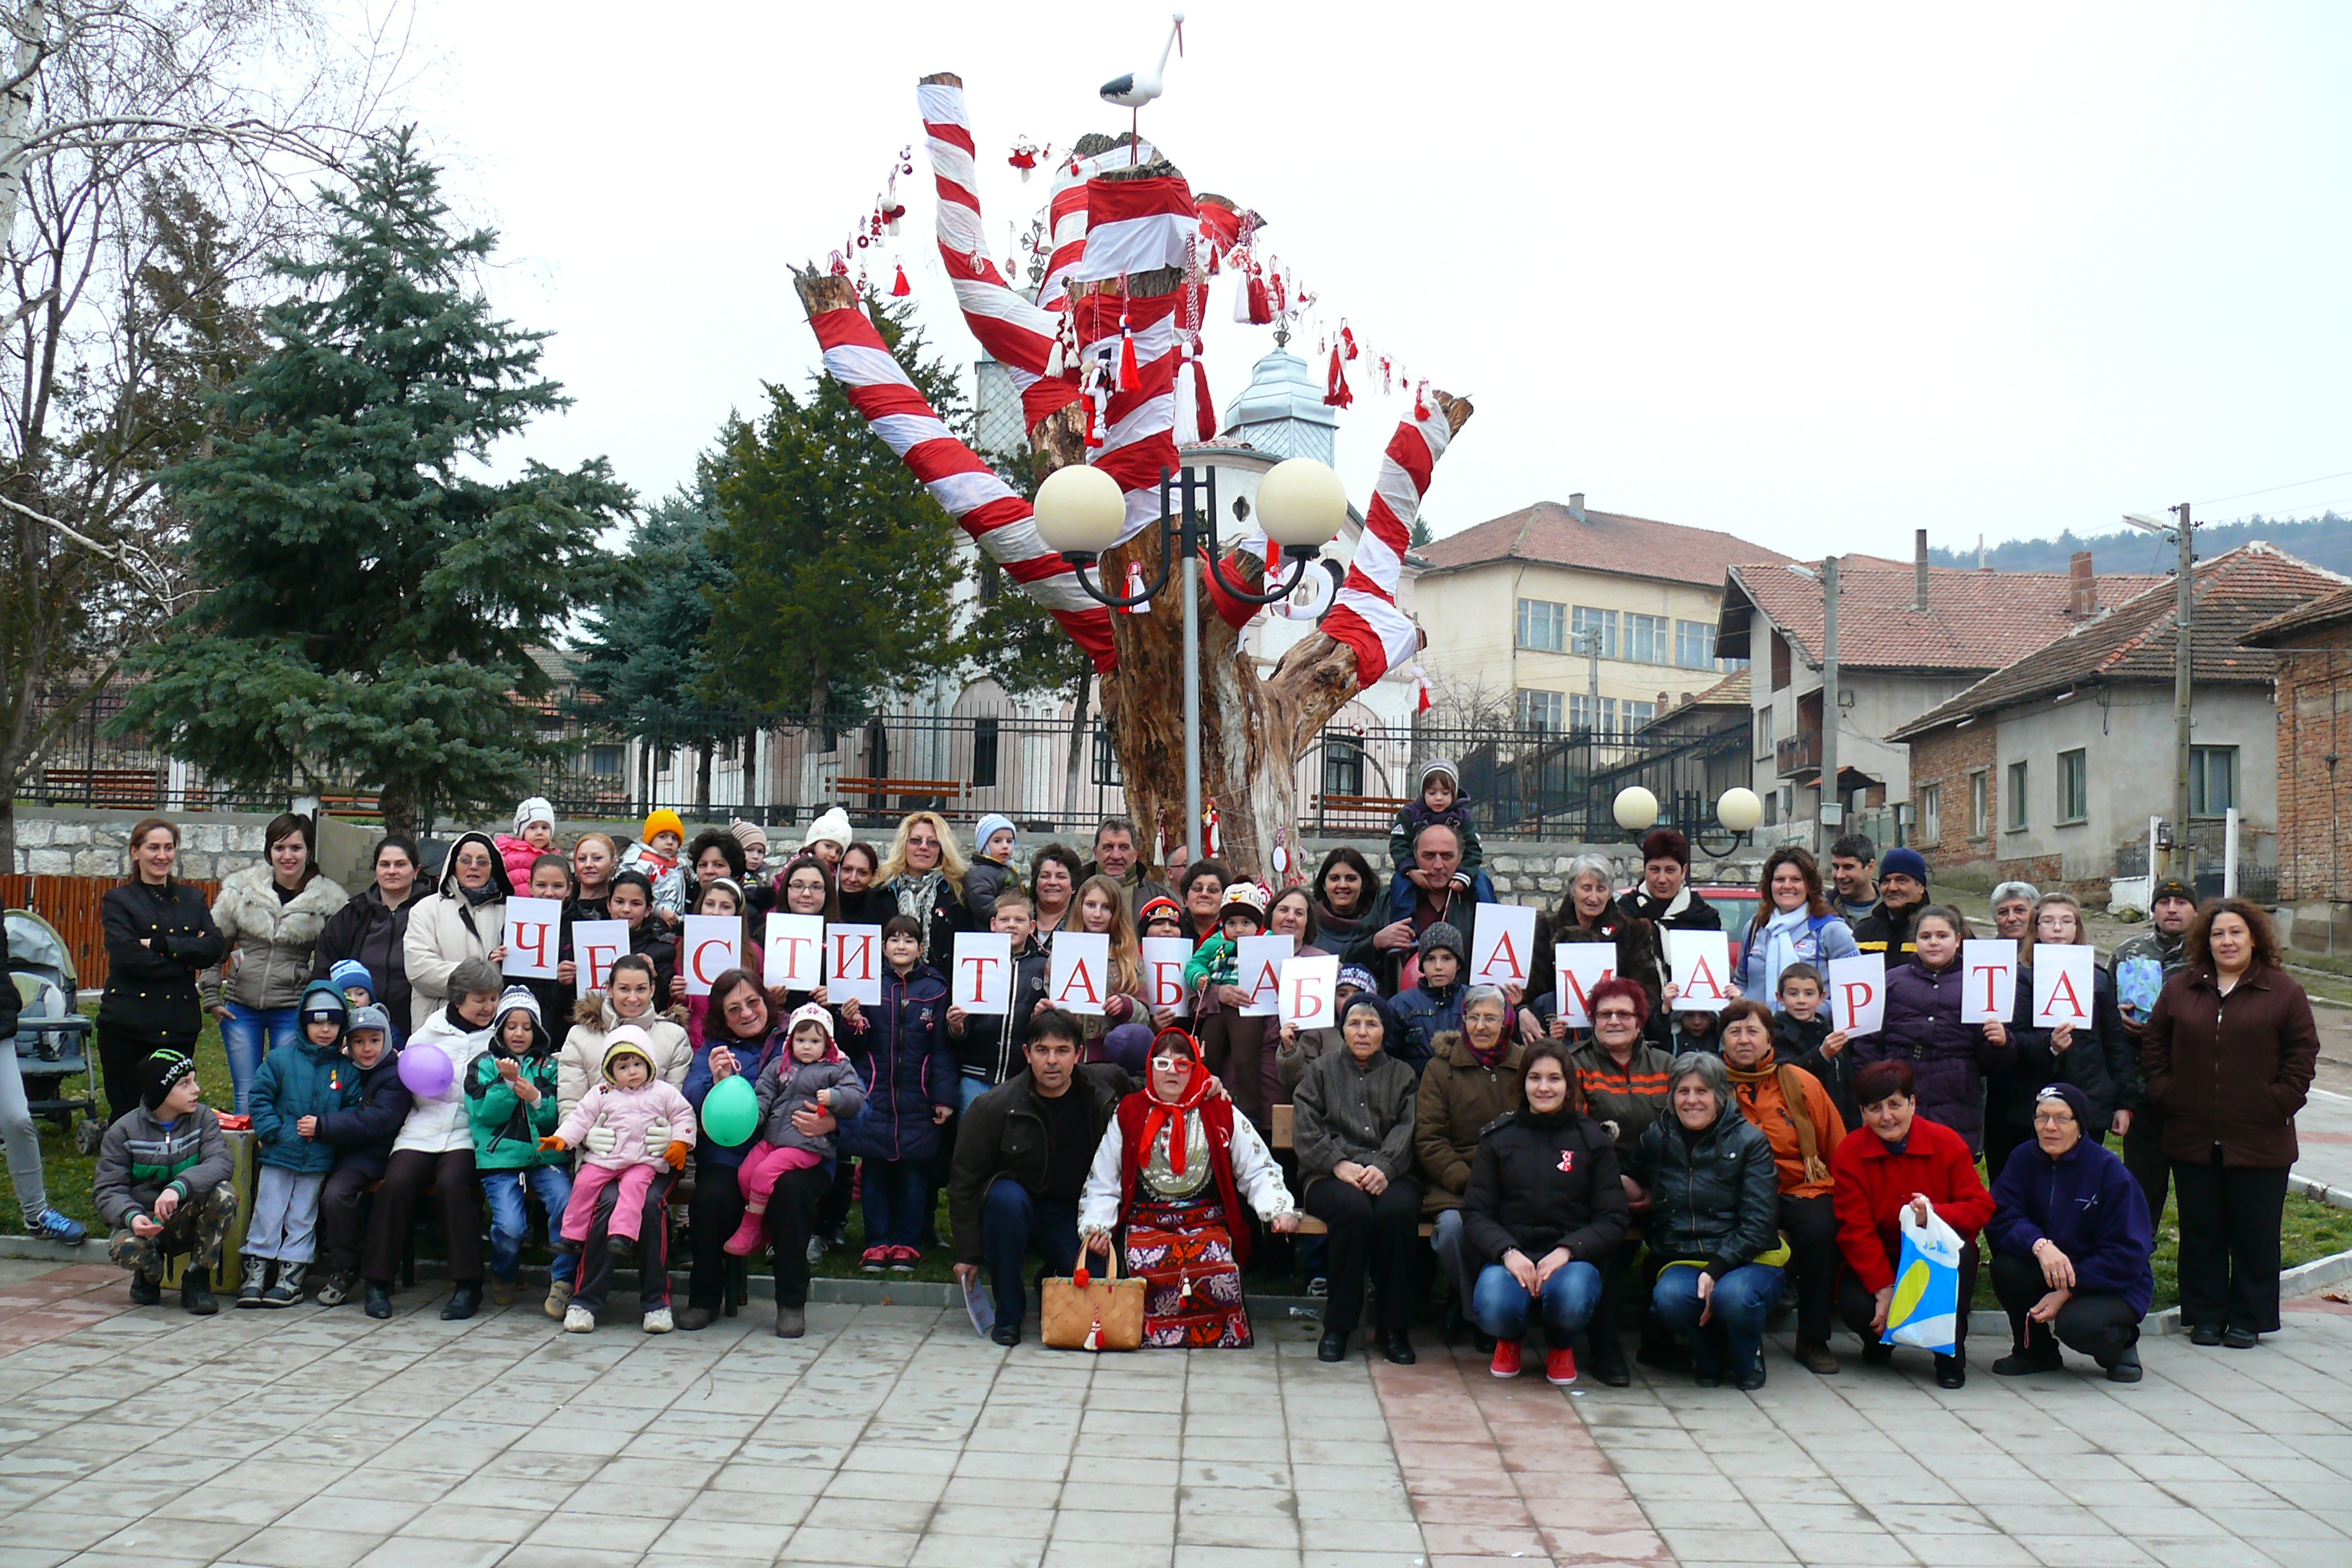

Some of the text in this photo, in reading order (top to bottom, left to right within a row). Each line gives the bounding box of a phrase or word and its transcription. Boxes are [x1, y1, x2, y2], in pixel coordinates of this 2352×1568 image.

[511, 921, 551, 968] Ч
[693, 939, 731, 985] С
[776, 937, 811, 979] Т
[832, 934, 875, 979] И
[1478, 930, 1526, 979] А
[582, 945, 617, 990] Е
[961, 957, 998, 1002] Т
[1056, 958, 1100, 1003] А
[1152, 962, 1183, 1005] Б
[1250, 959, 1279, 1005] А
[1680, 955, 1725, 999] А
[1972, 966, 2008, 1012] Т
[1288, 977, 1322, 1019] Б
[1840, 982, 1872, 1029] Р
[2040, 970, 2086, 1017] А
